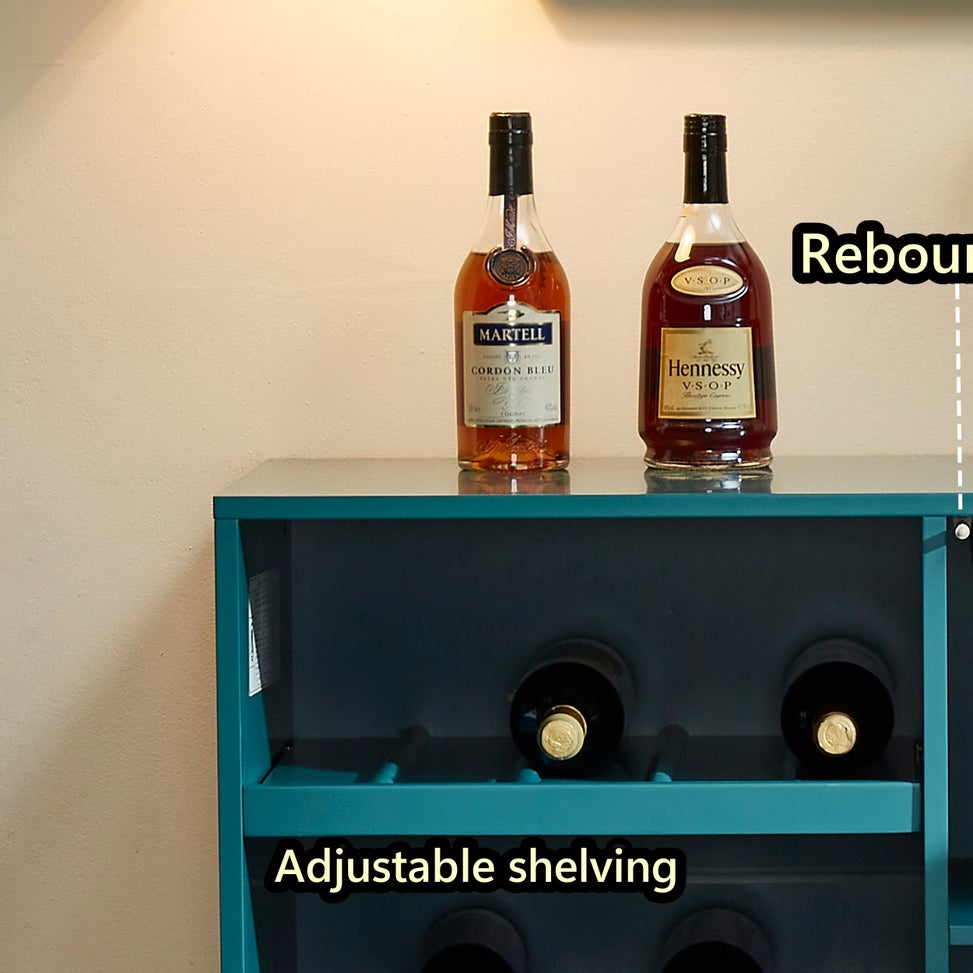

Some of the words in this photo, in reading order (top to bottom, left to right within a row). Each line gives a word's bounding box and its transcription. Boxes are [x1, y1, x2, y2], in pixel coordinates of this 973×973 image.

[479, 327, 546, 341] MARTELL
[471, 366, 522, 375] CORDON
[527, 365, 555, 375] BLEU
[668, 359, 746, 380] Hennessy
